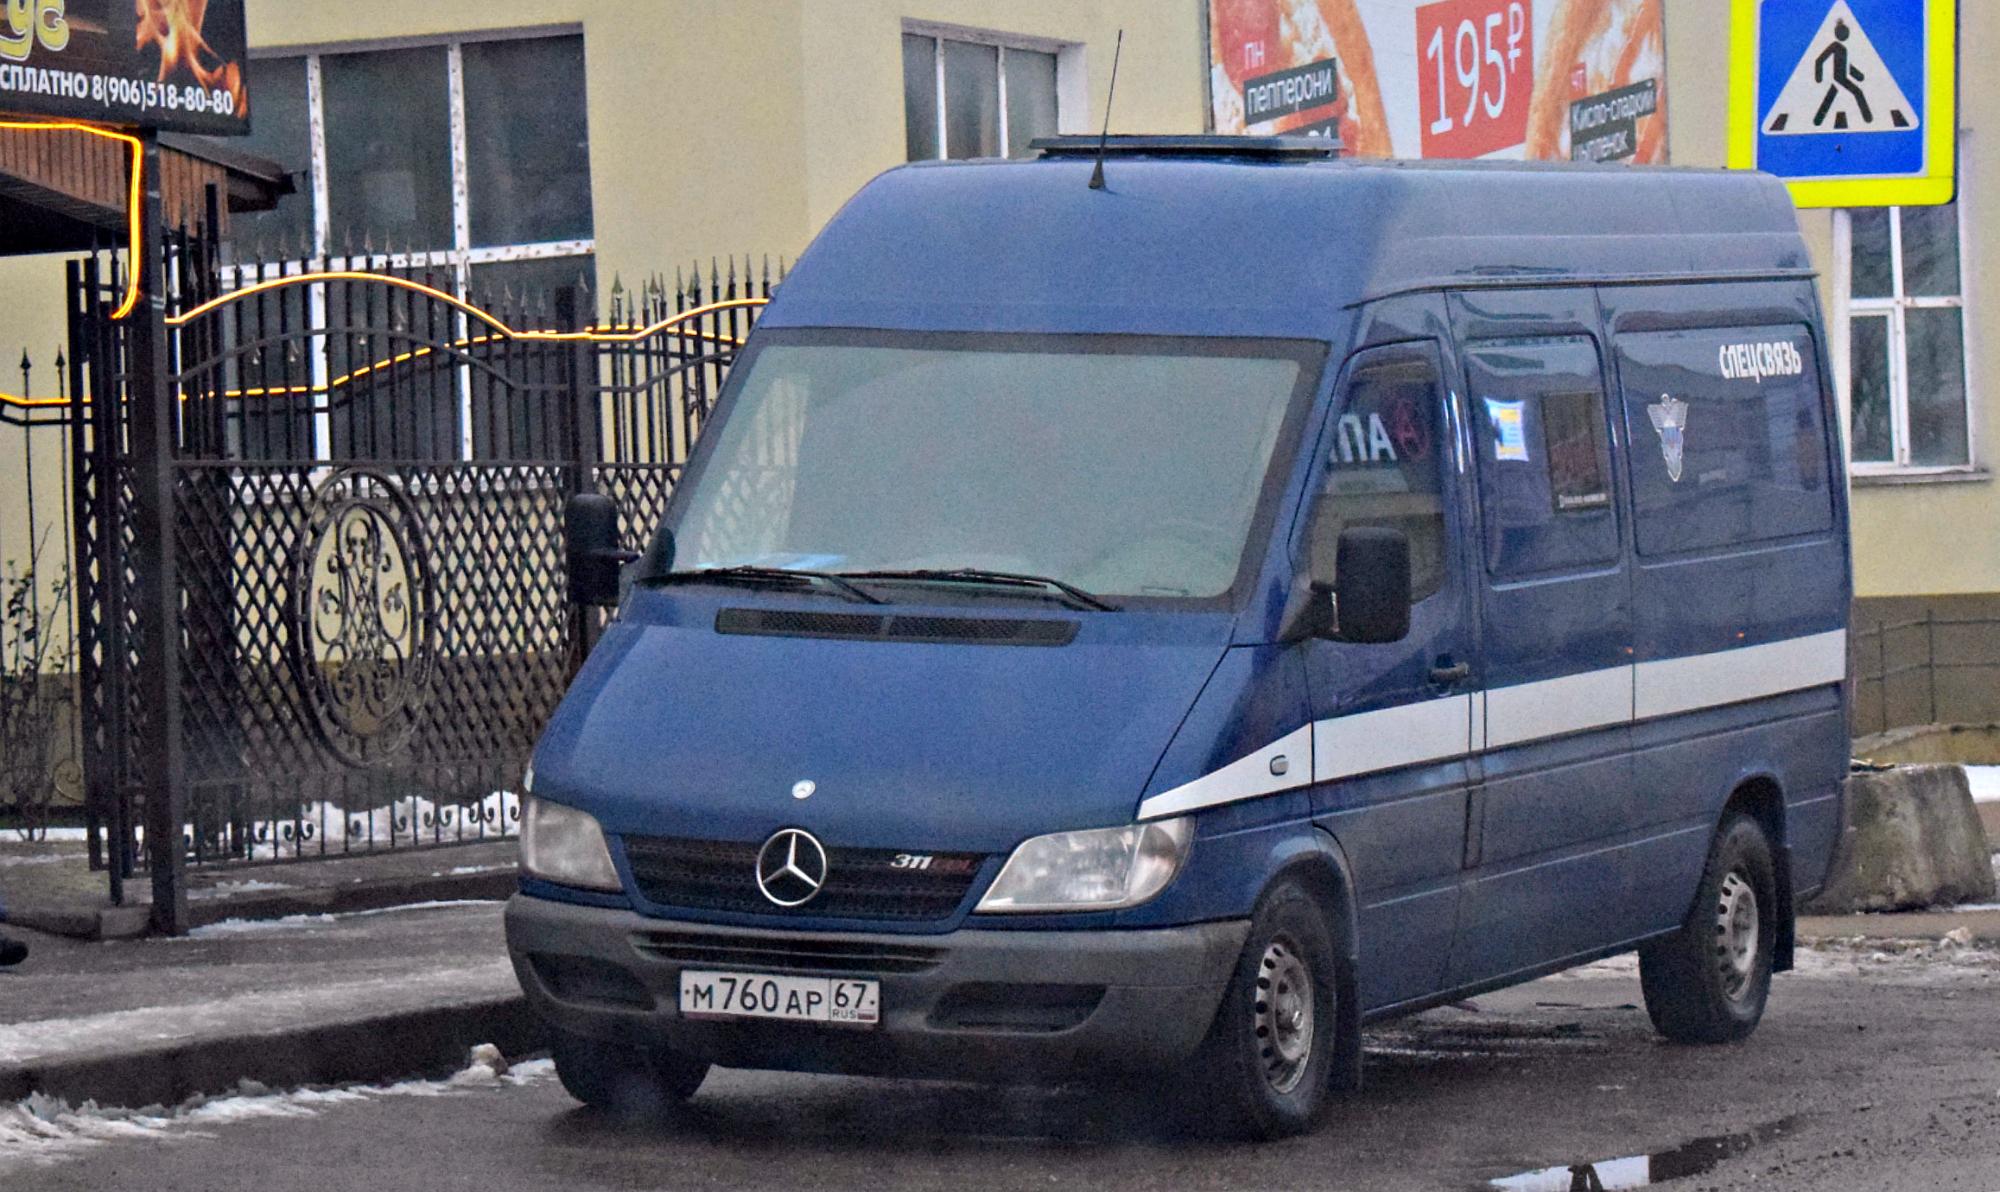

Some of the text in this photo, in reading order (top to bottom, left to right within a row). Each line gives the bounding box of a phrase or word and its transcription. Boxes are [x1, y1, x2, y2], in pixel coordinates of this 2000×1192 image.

[92, 75, 234, 116] 8(906)518-80-80
[1247, 68, 1333, 115] пепперони
[1719, 341, 1803, 384] СПЕЦСВЯЗЬ
[890, 853, 934, 870] 311
[834, 982, 868, 1009] 67
[831, 1007, 858, 1020] RUS
